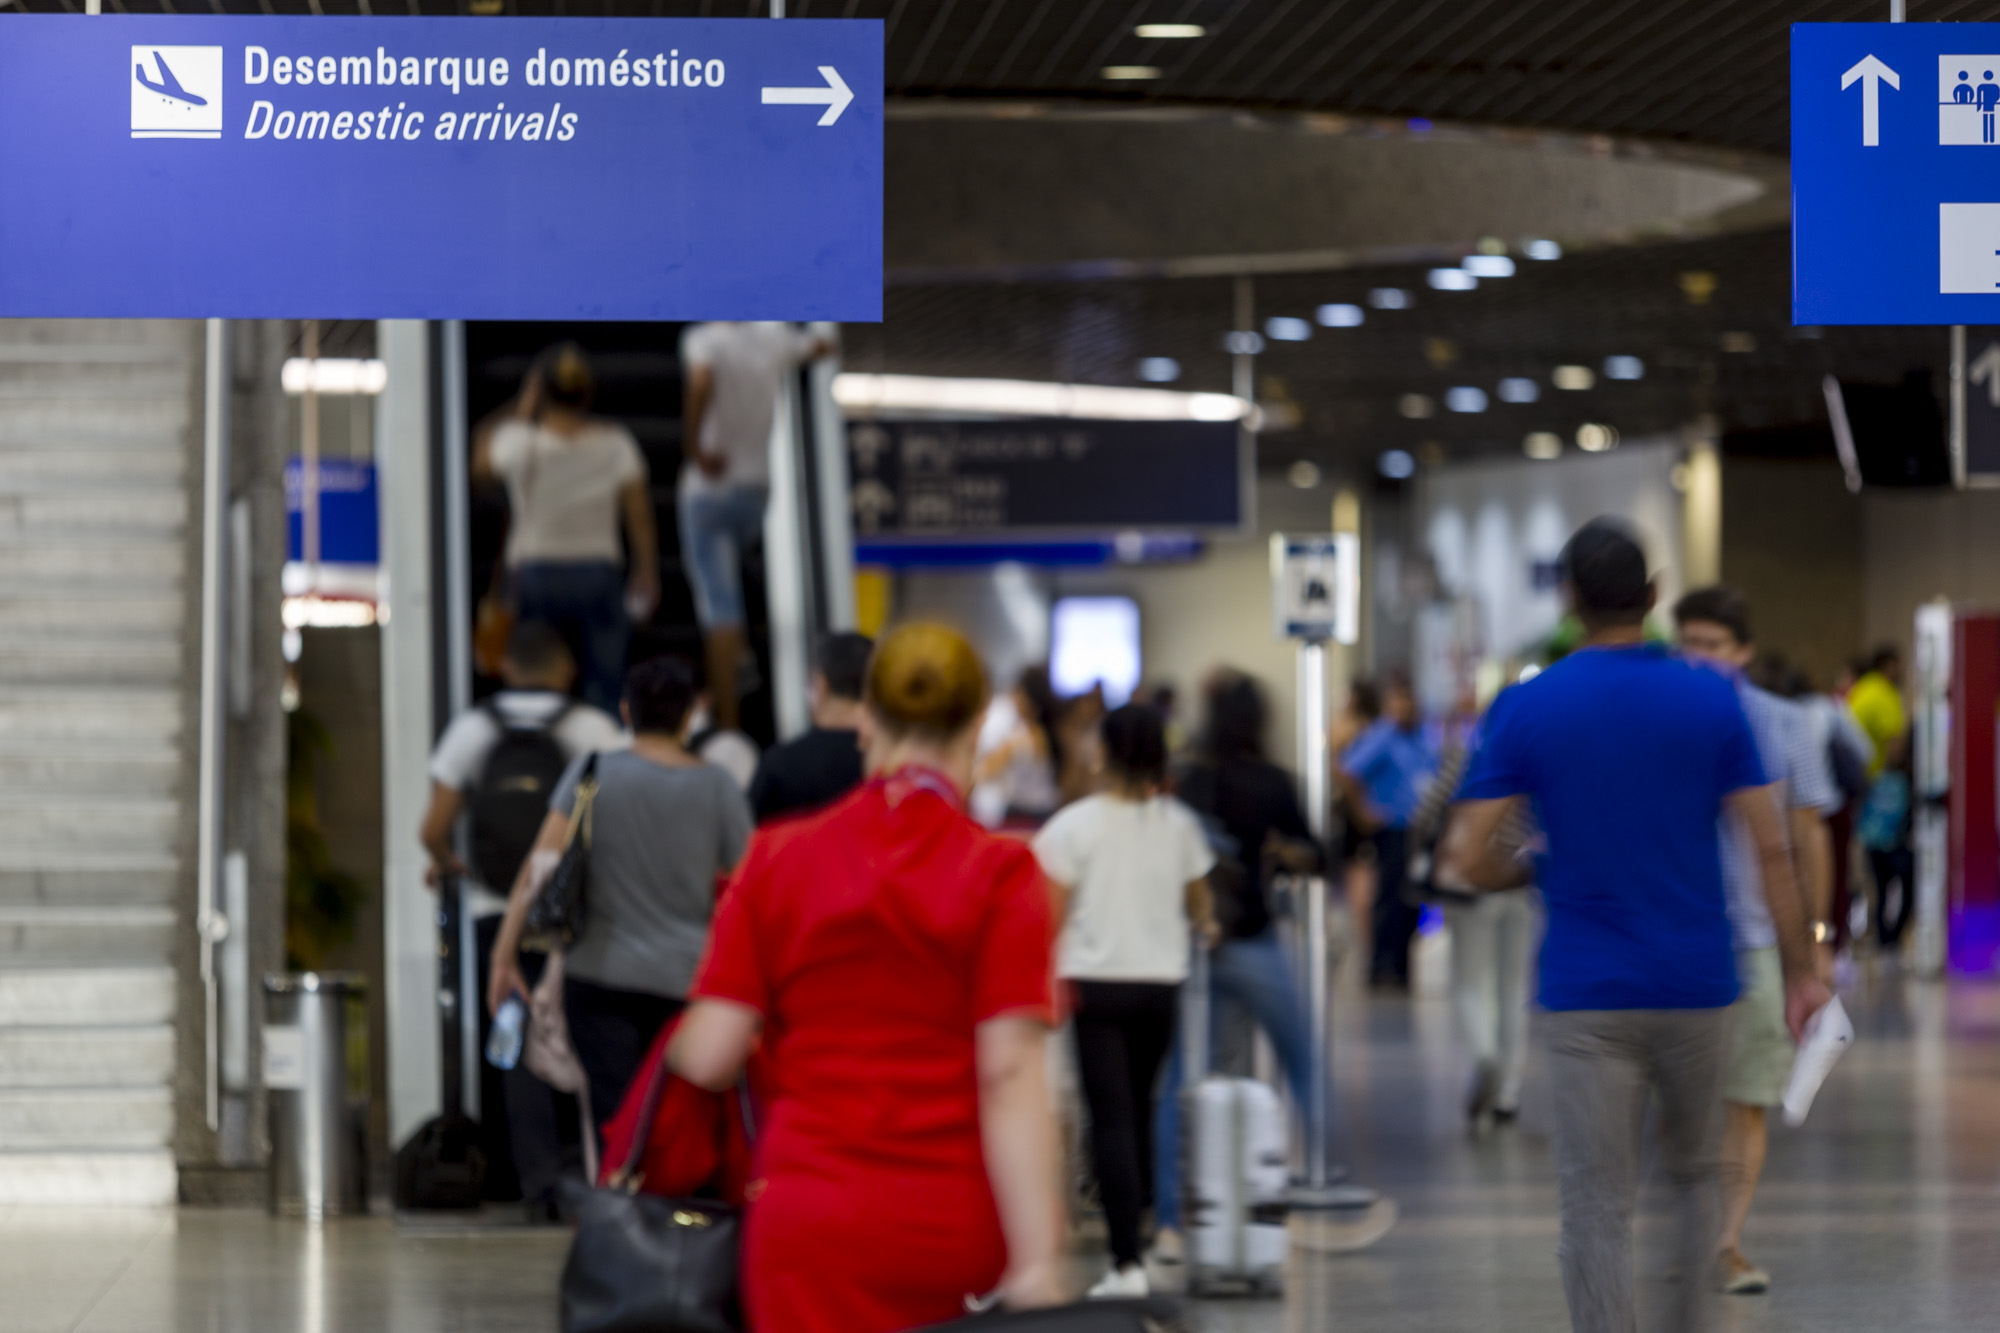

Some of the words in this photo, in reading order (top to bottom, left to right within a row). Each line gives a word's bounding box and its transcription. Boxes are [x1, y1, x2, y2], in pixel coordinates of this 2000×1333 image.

[244, 46, 509, 94] Desembarque
[525, 47, 726, 87] doméstico
[244, 100, 425, 141] Domestic
[434, 102, 579, 141] arrivals
